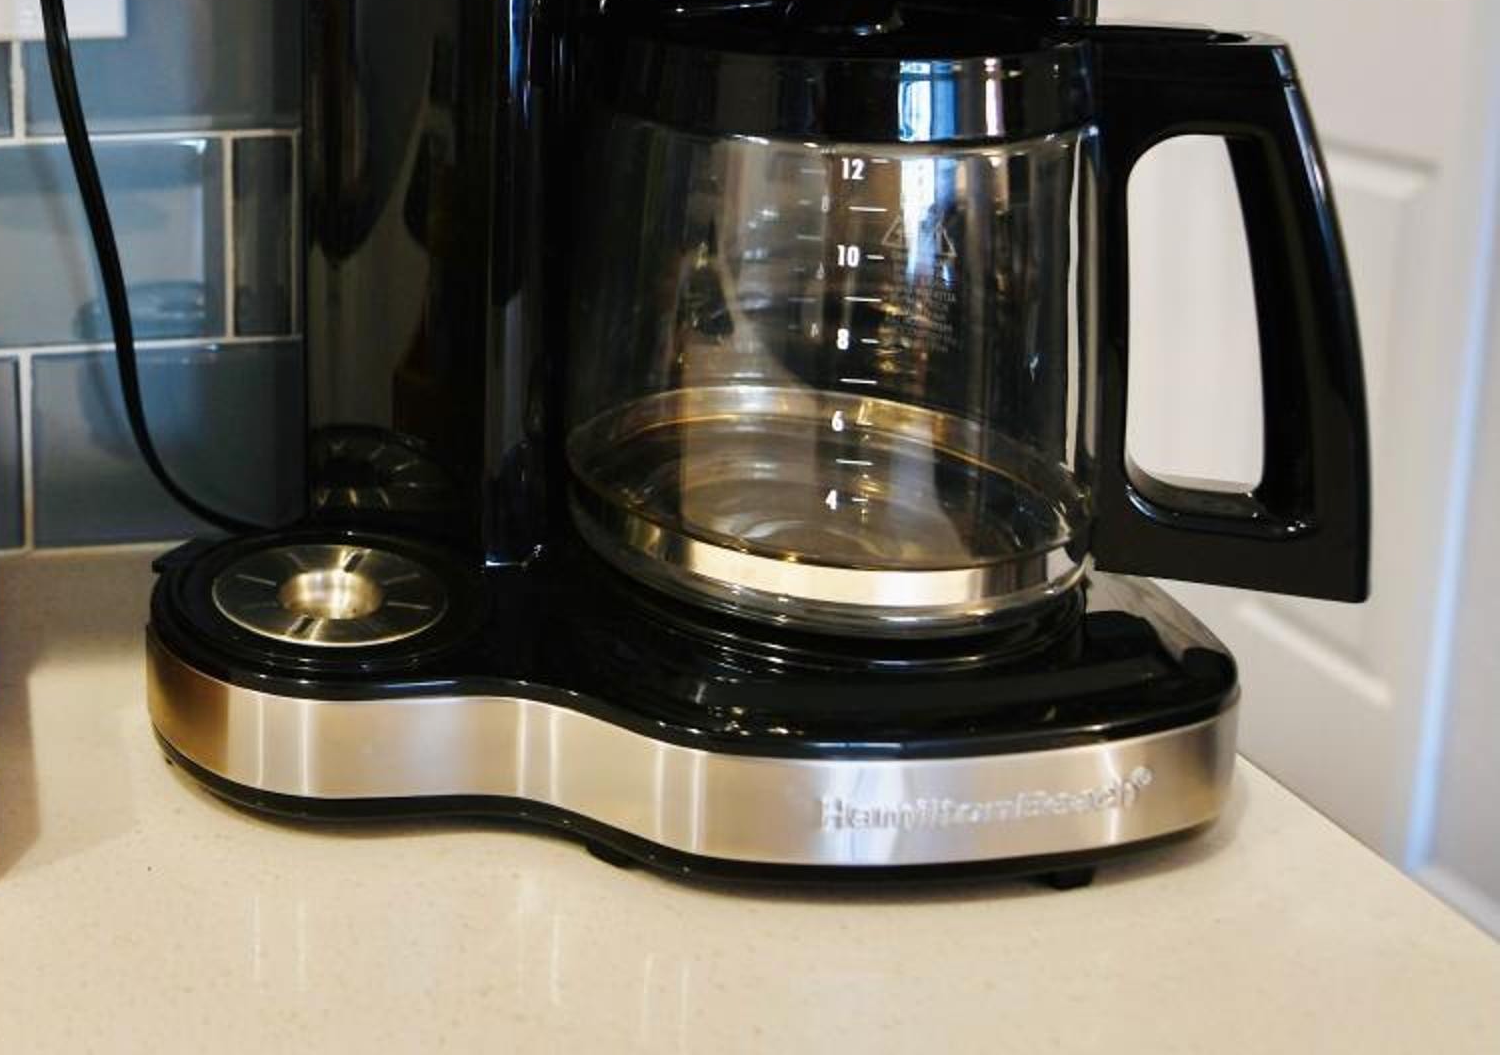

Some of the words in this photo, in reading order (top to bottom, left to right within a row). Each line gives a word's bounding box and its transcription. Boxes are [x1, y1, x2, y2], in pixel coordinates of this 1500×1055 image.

[841, 157, 866, 181] 12
[837, 244, 861, 268] 10
[836, 327, 850, 351] 8
[831, 410, 844, 432] 6
[825, 488, 838, 511] 4
